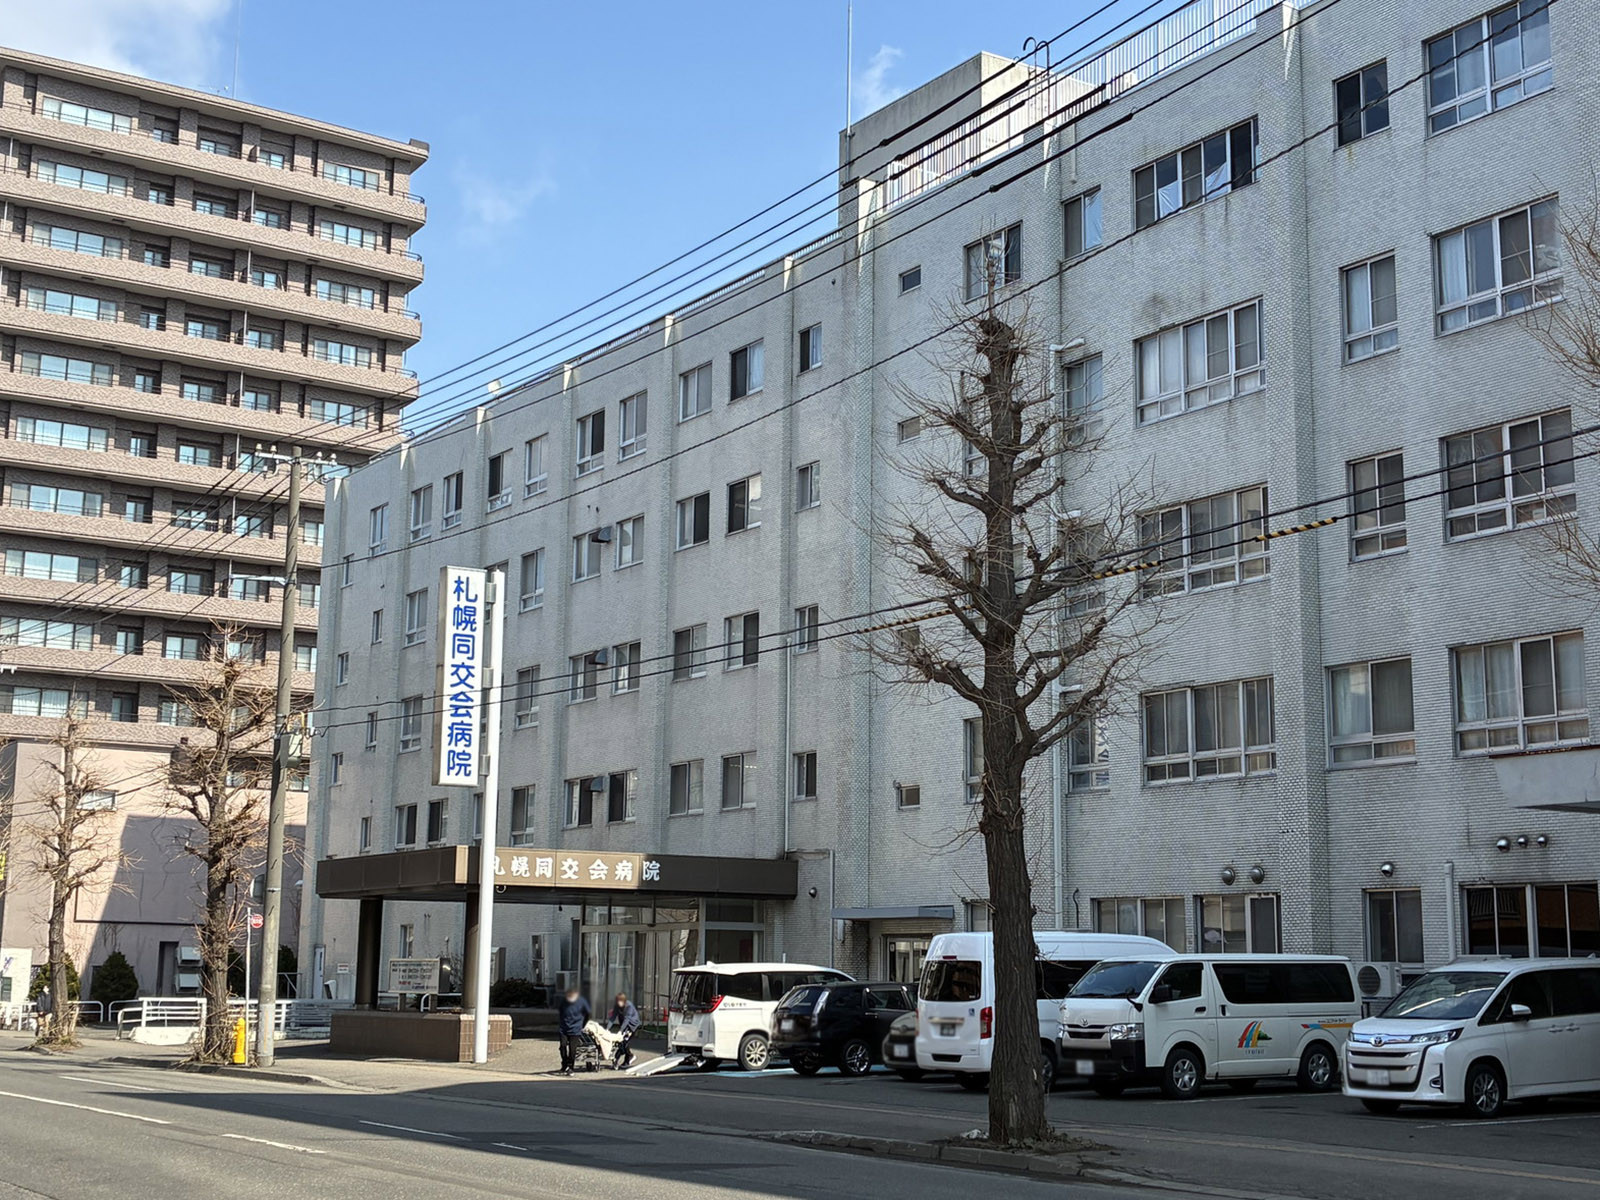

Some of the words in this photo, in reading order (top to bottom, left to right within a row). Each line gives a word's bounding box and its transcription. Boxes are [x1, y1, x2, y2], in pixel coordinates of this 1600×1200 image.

[447, 575, 478, 777] 札幌同交会病院
